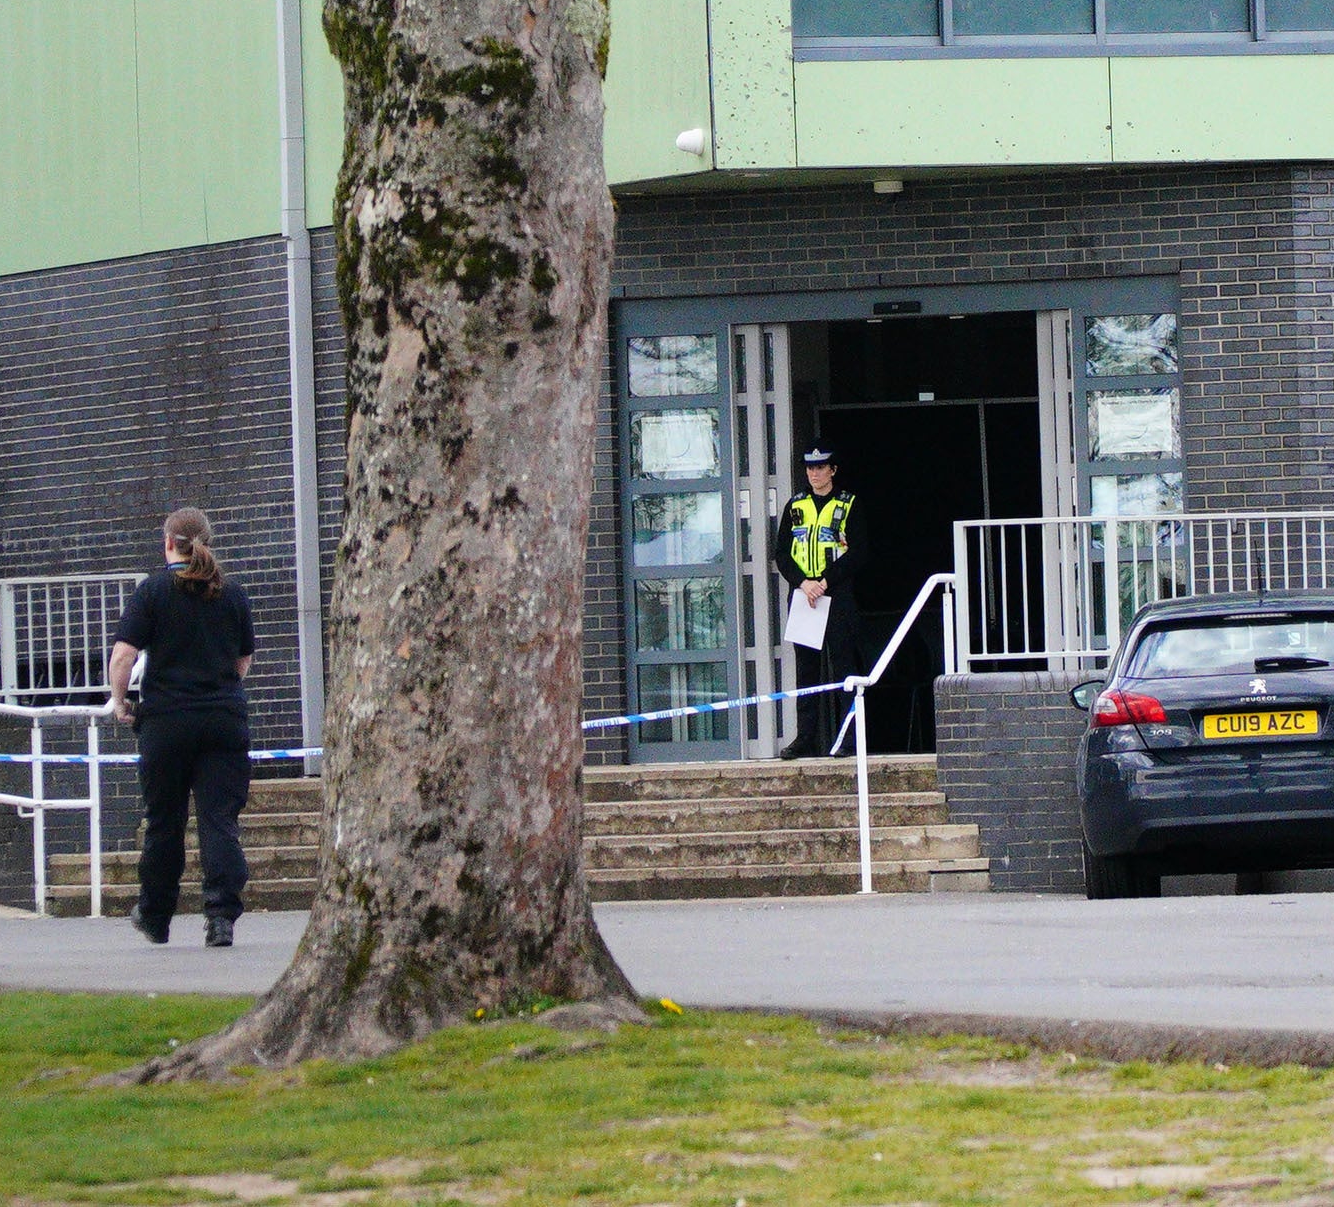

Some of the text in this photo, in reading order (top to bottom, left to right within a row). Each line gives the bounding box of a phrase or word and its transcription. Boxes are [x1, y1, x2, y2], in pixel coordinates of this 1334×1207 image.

[1240, 695, 1277, 703] PEUGEOT
[1217, 713, 1305, 733] CU19 AZC
